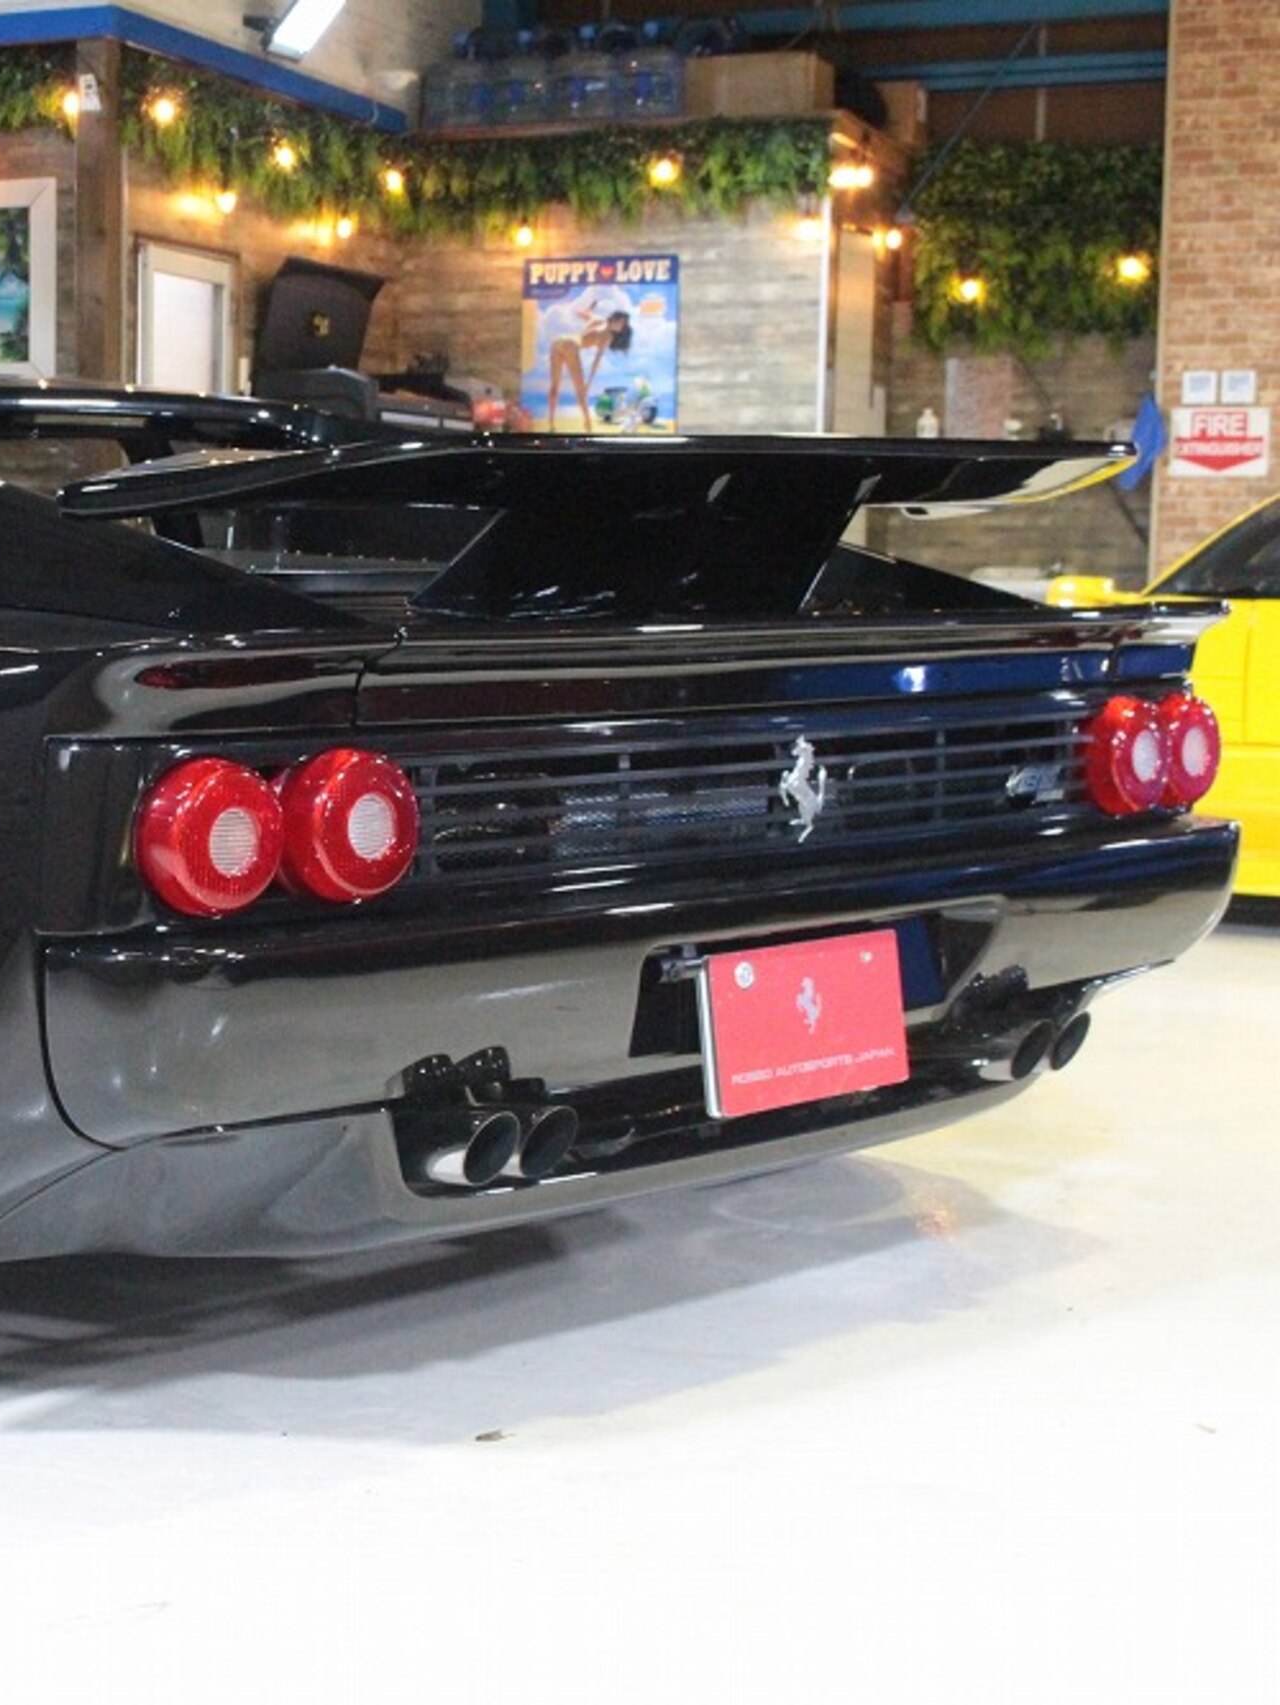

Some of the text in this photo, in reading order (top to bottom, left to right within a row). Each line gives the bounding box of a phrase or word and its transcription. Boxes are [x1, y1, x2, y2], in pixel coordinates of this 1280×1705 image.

[528, 258, 671, 286] PUPPY LOVE
[1194, 413, 1247, 437] FIRE
[854, 1047, 895, 1064] JAPAN
